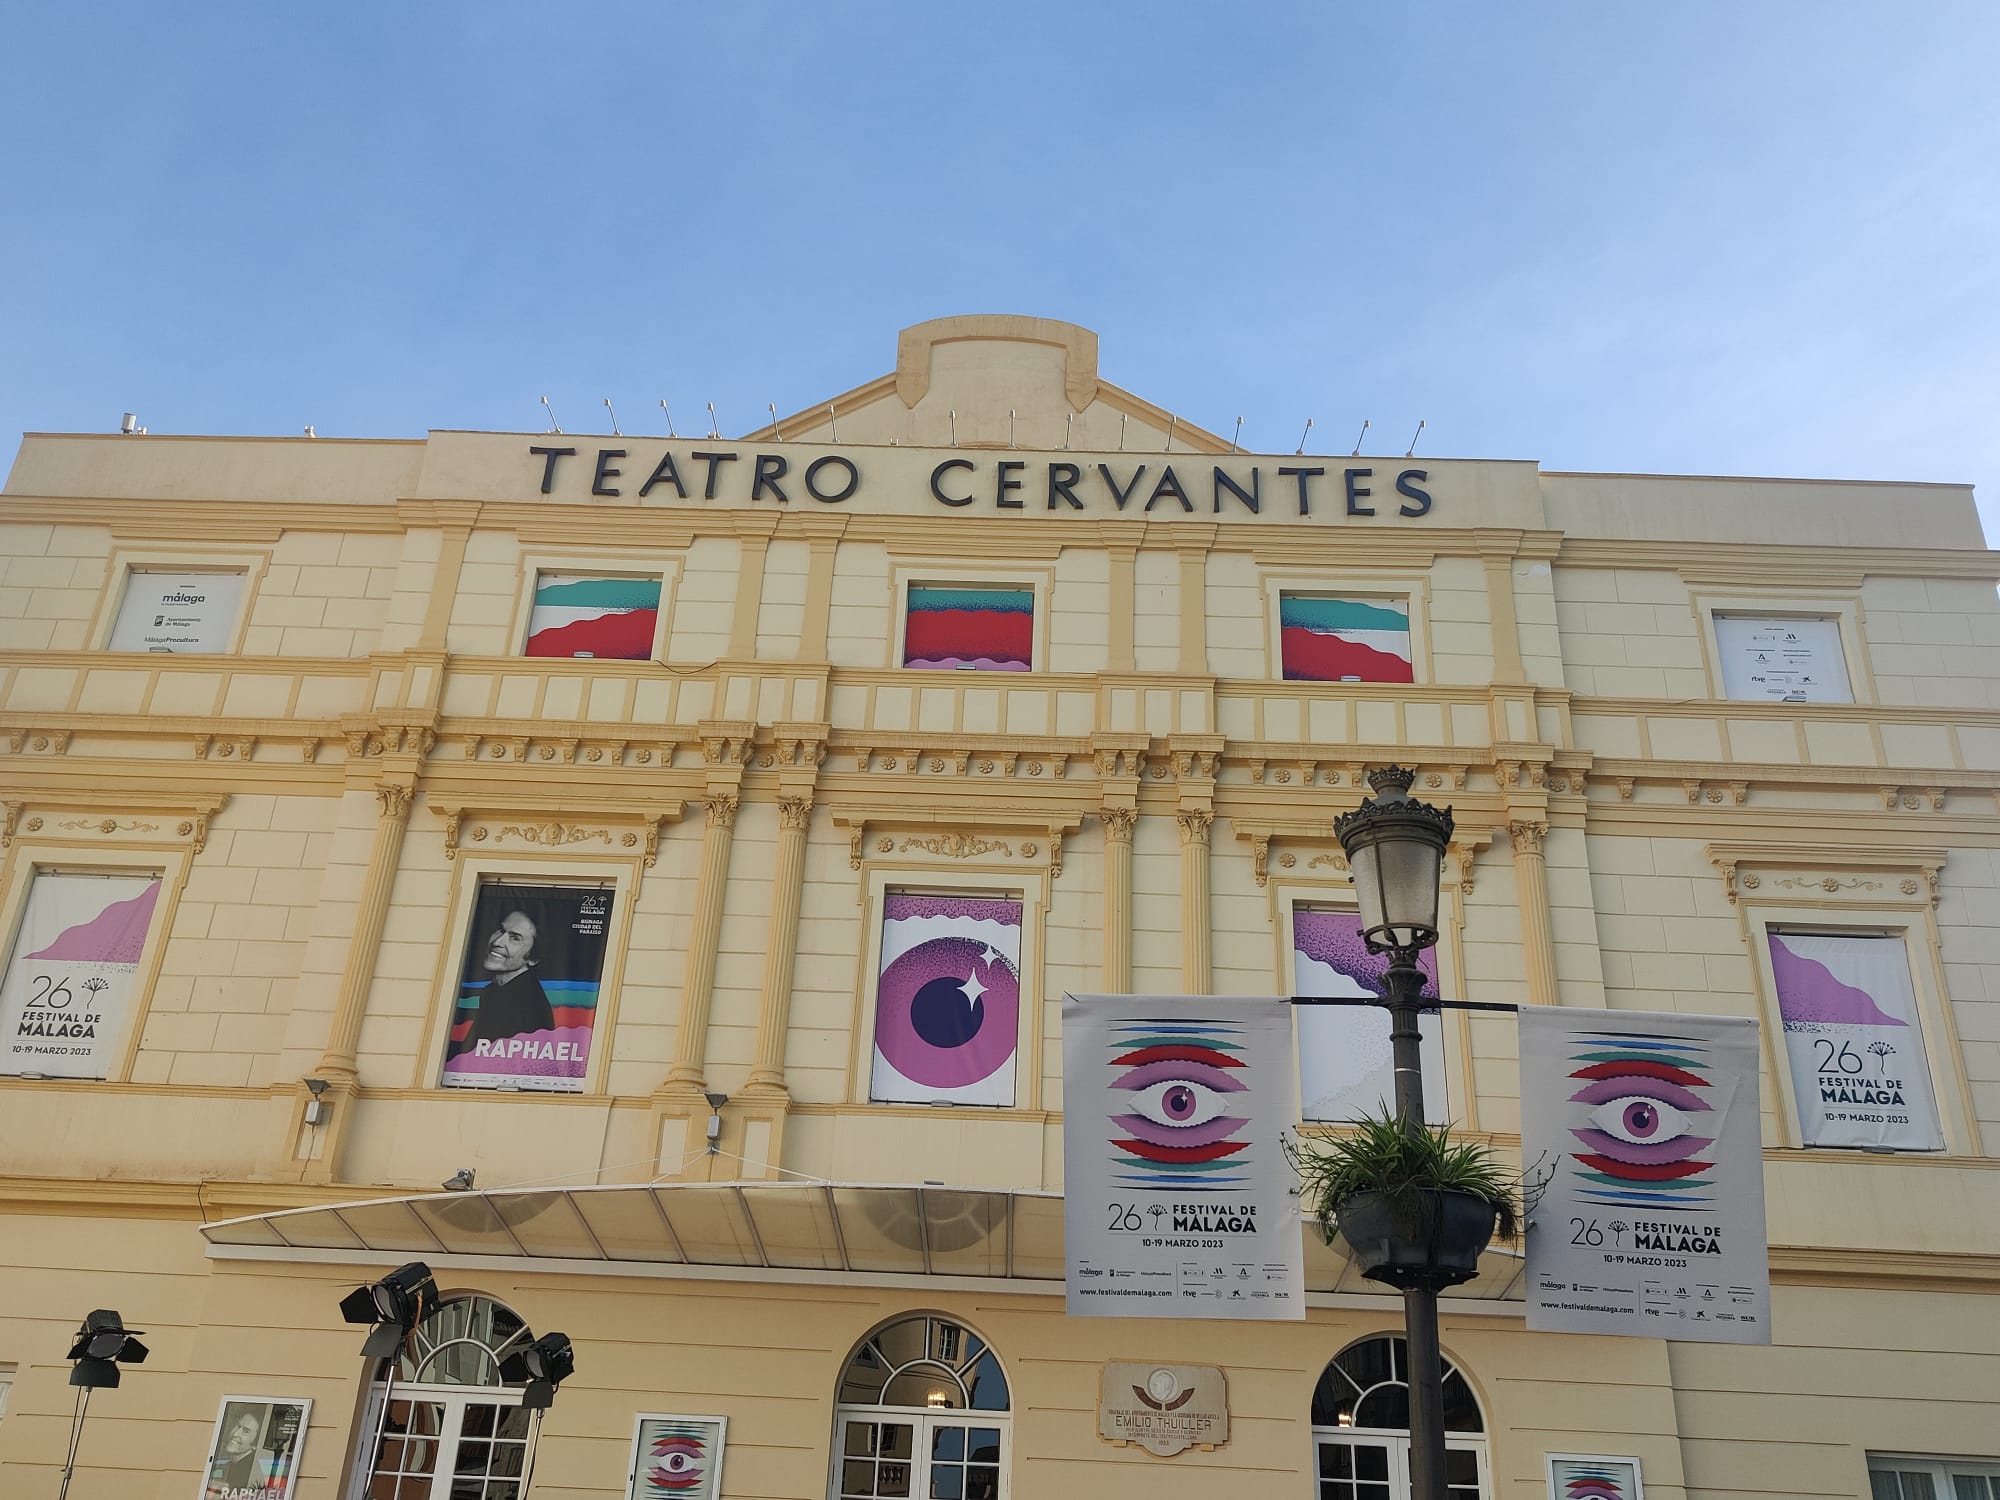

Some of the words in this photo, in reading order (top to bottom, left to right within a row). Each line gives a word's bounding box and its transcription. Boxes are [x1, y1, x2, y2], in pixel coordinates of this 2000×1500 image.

[530, 446, 859, 503] TEATRO
[930, 459, 1433, 517] CERVANTES
[162, 592, 205, 604] málaga
[582, 895, 597, 906] 26
[26, 975, 72, 1008] 26
[22, 1011, 79, 1022] FESTIVAL
[85, 1014, 101, 1023] DE
[17, 1020, 95, 1038] MÁLAGA
[12, 1045, 33, 1053] 10-19
[34, 1046, 68, 1055] MARZO
[70, 1047, 91, 1056] 2023
[475, 1038, 584, 1062] RAPHAEL
[1814, 1039, 1863, 1074] 26
[1819, 1077, 1881, 1089] FESTIVAL
[1886, 1079, 1903, 1089] DE
[1821, 1087, 1906, 1106] MÁLAGA
[1825, 1112, 1847, 1121] 10-19
[1850, 1114, 1884, 1123] MARZO
[1887, 1115, 1909, 1124] 2023
[1108, 1203, 1142, 1231] 26
[1173, 1204, 1233, 1216] FESTIVAL
[1240, 1206, 1257, 1216] DE
[1173, 1214, 1257, 1233] MÁLAGA
[1634, 1221, 1698, 1236] FESTIVAL
[1704, 1226, 1721, 1237] DE
[1570, 1217, 1604, 1246] 26
[1142, 1238, 1163, 1247] 10-19
[1165, 1240, 1199, 1248] MARZO
[1201, 1239, 1224, 1248] 2023
[1635, 1233, 1721, 1254] MÁLAGA
[1603, 1254, 1624, 1264] 10-19
[1627, 1257, 1662, 1266] MARZO
[1664, 1258, 1687, 1268] 2023
[1079, 1288, 1172, 1298] www.festivaldemalaga.com
[1540, 1302, 1634, 1314] www.festivaldemalaga.com
[1645, 1308, 1660, 1316] rtve
[1115, 1415, 1151, 1428] EMILIO
[1156, 1417, 1211, 1431] THUILLER
[220, 1487, 283, 1500] RAPHAEL
